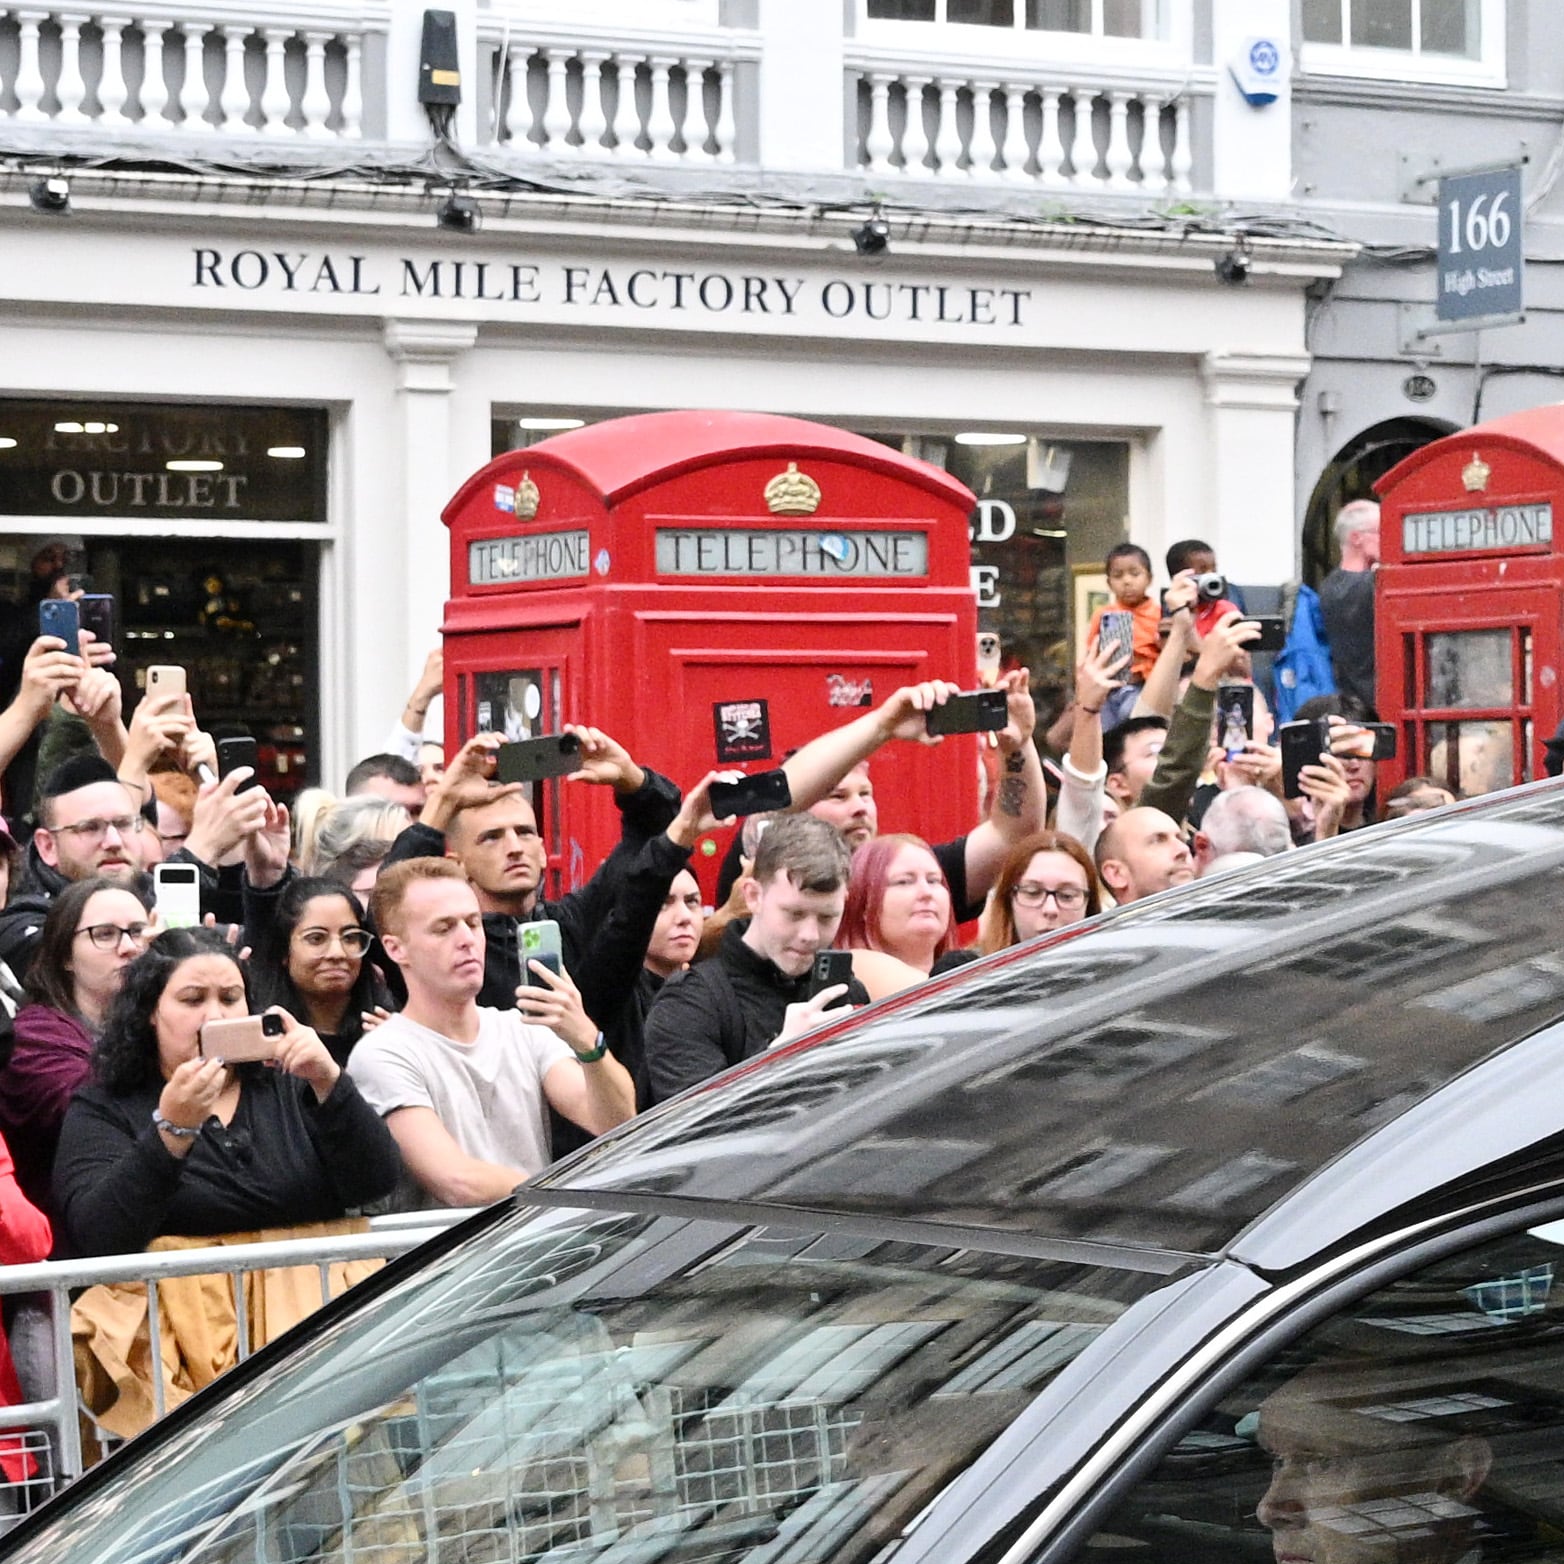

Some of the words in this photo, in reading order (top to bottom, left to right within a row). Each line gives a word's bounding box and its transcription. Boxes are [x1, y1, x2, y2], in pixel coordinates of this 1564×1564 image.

[1449, 190, 1511, 254] 166
[191, 248, 381, 296] ROYAL
[398, 258, 543, 303] MILE
[560, 266, 805, 315] FACTORY
[821, 280, 1033, 327] OUTLET
[1444, 269, 1476, 296] High
[1477, 266, 1515, 289] Street
[51, 469, 249, 508] OUTLET
[1410, 508, 1549, 549] TELEPHONE
[475, 535, 587, 580] TELEPHONE
[664, 532, 916, 574] TELEPHONE
